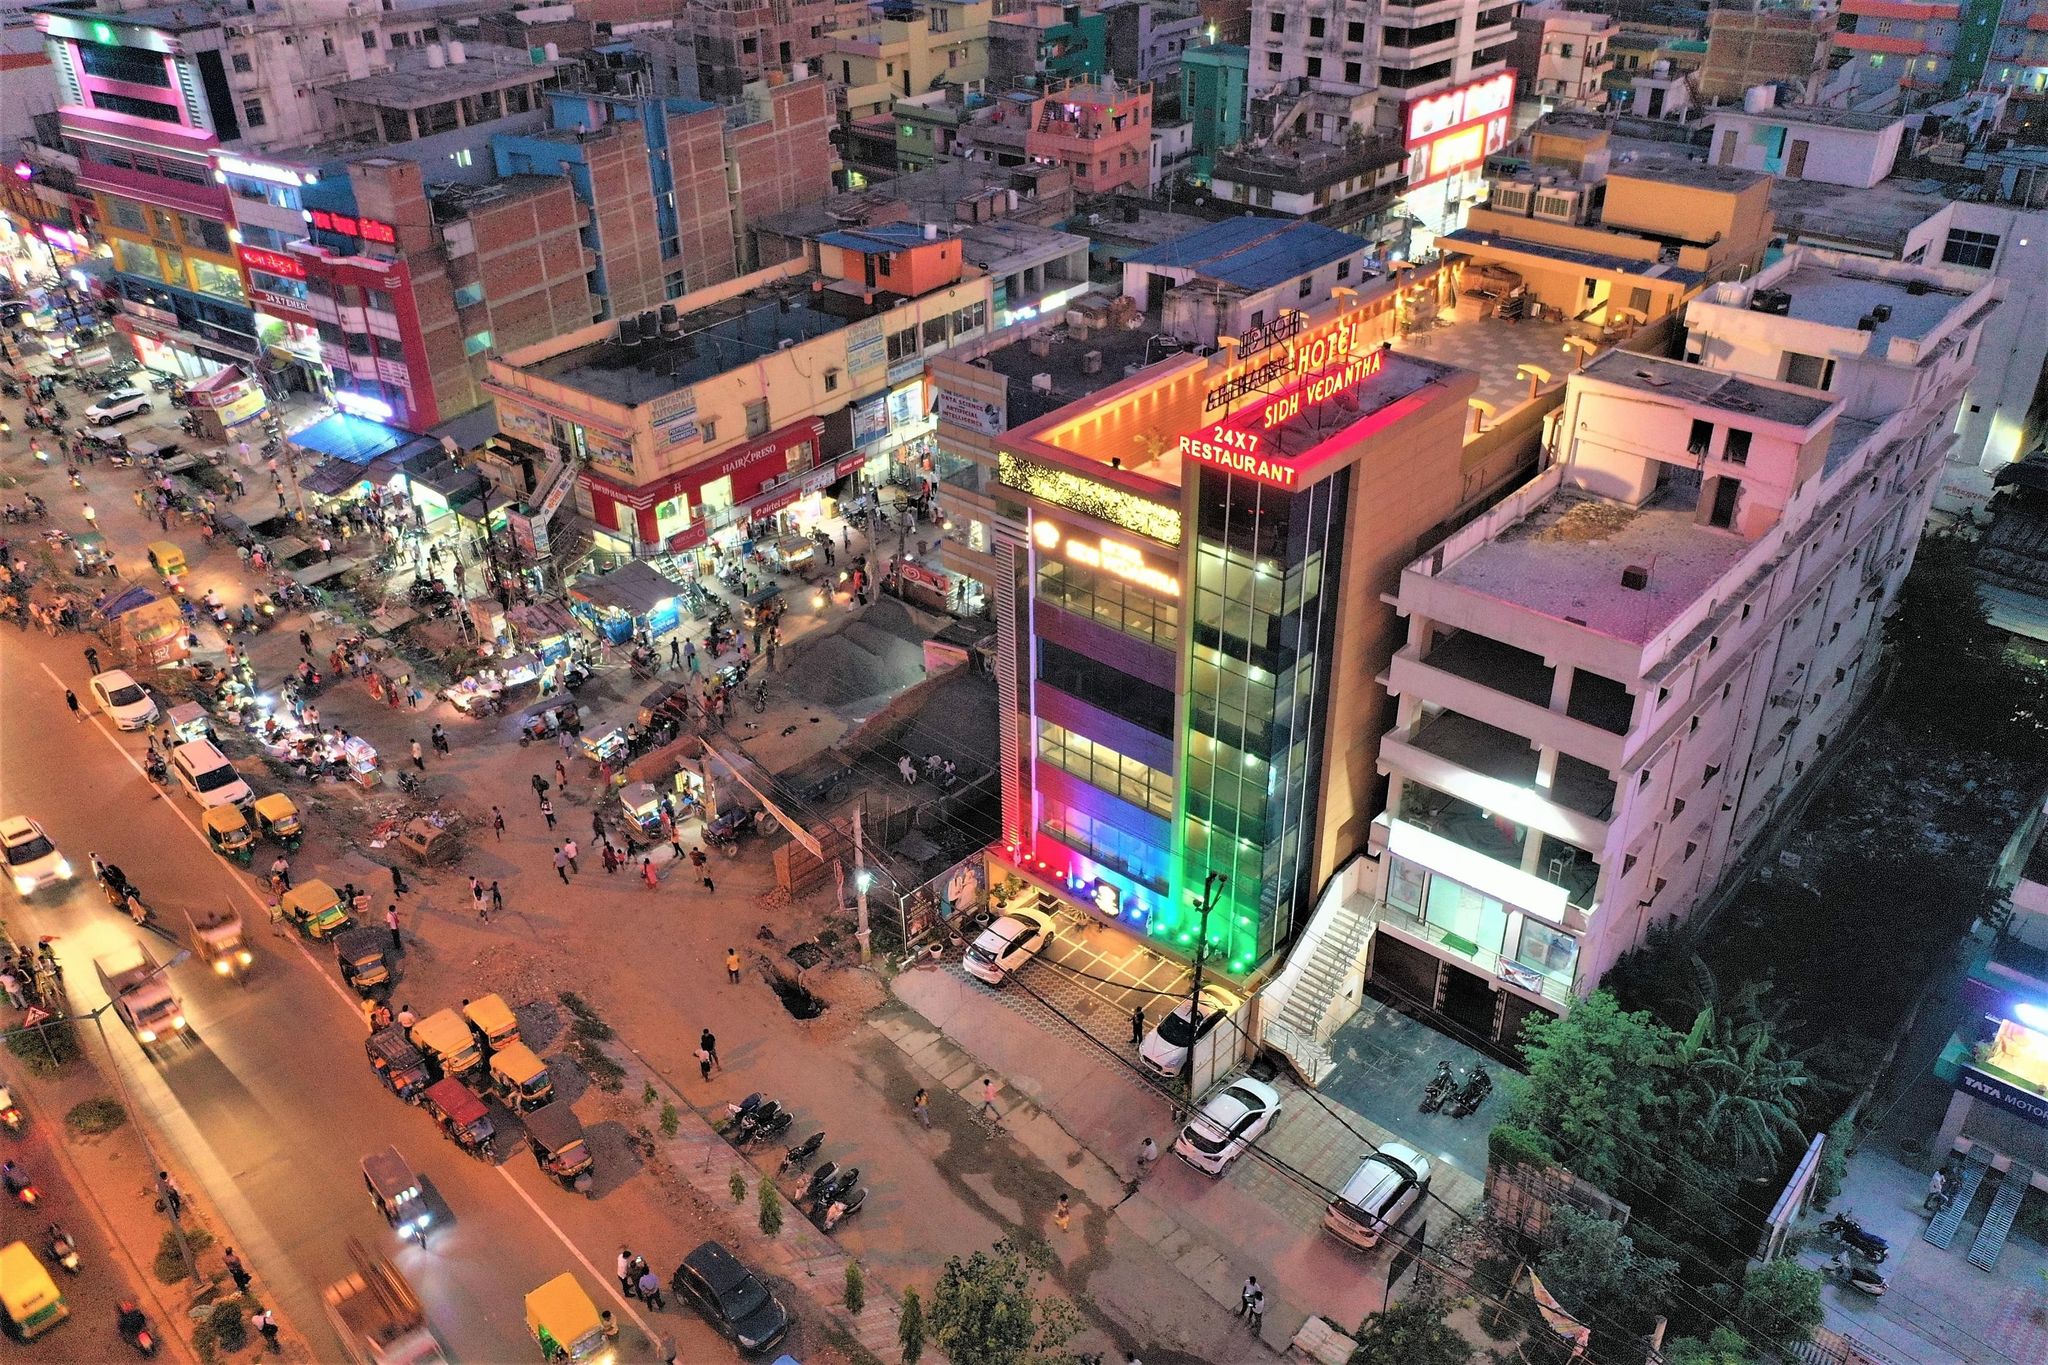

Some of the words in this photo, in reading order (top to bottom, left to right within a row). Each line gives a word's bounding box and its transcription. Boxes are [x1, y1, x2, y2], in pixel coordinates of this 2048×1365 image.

[1296, 322, 1359, 375] HOTEL
[1265, 393, 1299, 429] SIDH
[1307, 352, 1381, 405] VEDANTHA
[941, 394, 957, 403] DATA
[959, 400, 984, 412] SCIENCE
[946, 404, 977, 419] ARTIFICIAL
[942, 410, 983, 426] INTELLIGENCE
[1214, 425, 1258, 452] 24X7
[1179, 436, 1295, 484] RESTAURANT
[762, 498, 781, 514] airtel
[1964, 1076, 2001, 1099] TATA
